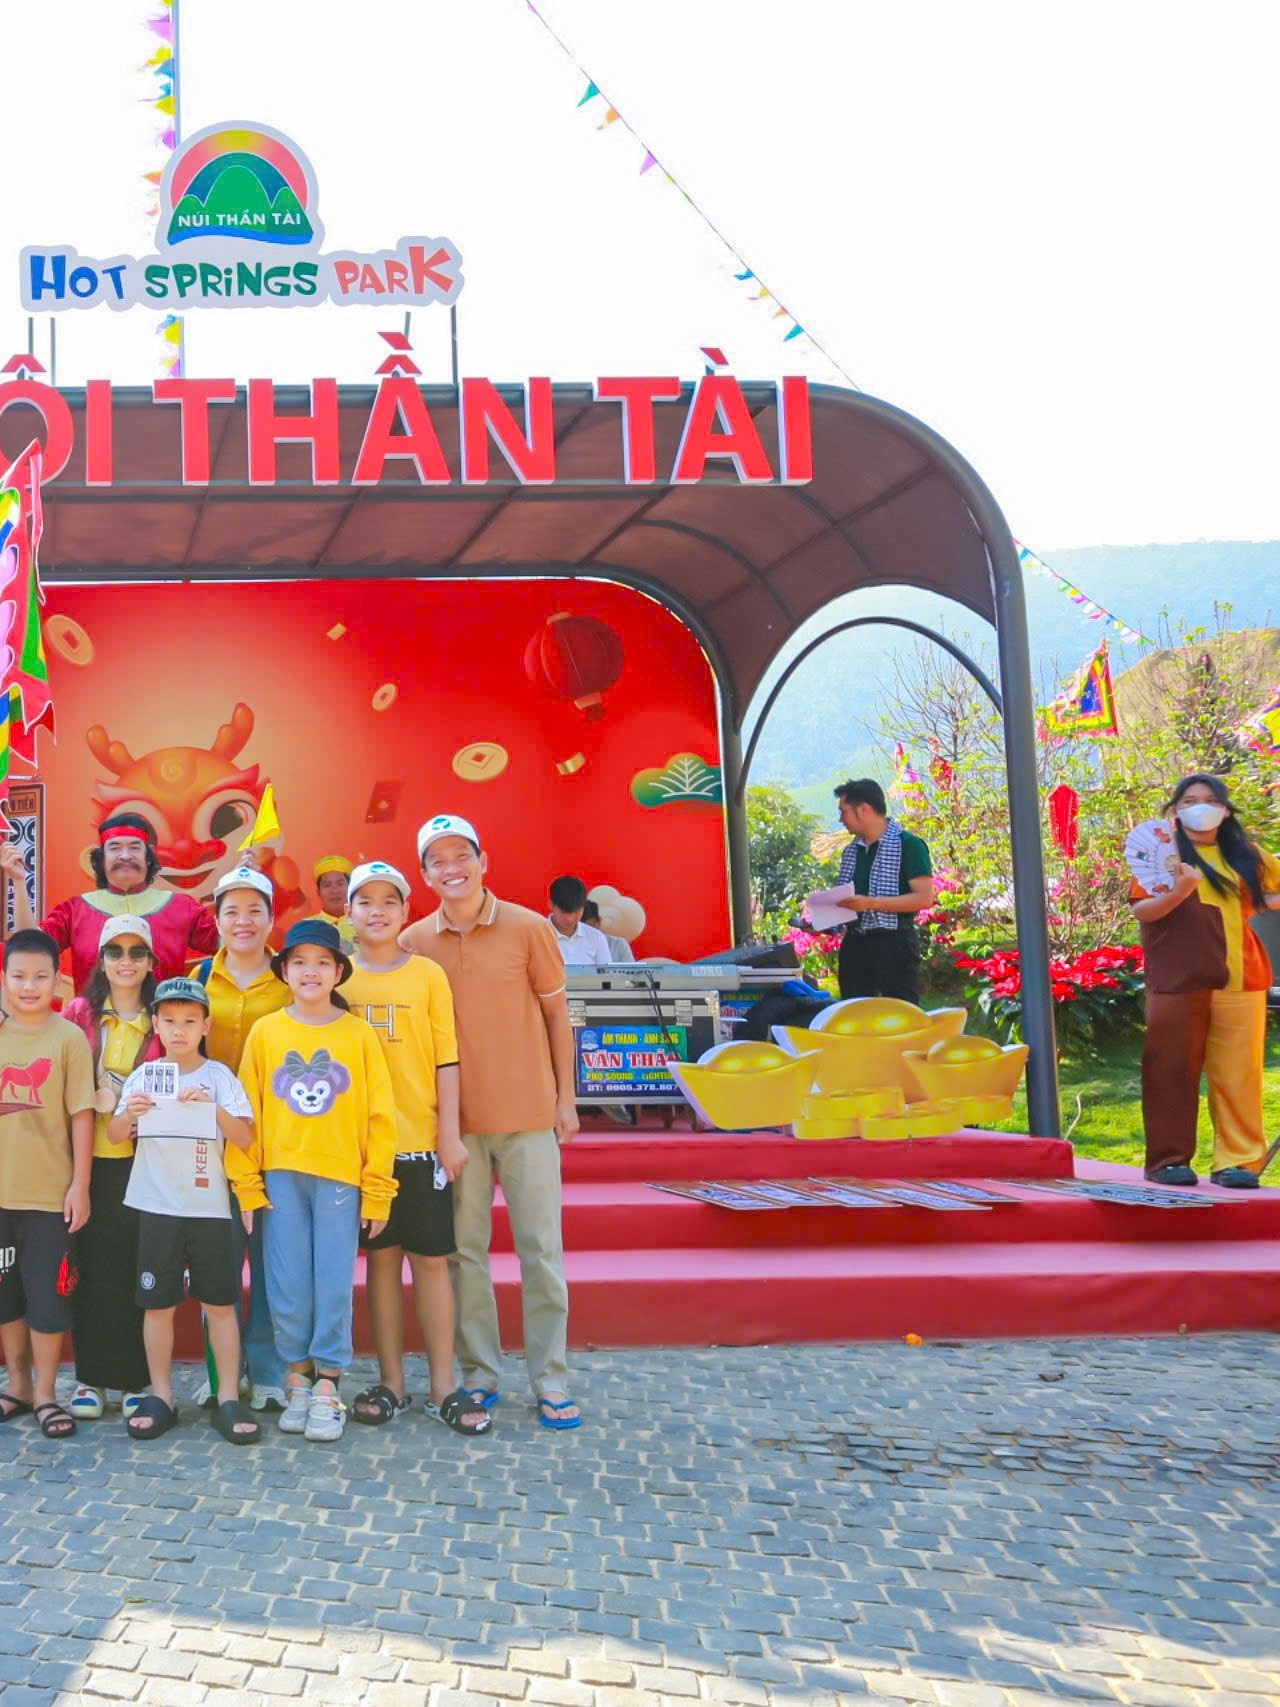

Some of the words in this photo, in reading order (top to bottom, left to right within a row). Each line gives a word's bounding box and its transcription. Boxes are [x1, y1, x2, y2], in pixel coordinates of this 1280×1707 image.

[178, 211, 209, 227] NÚI
[272, 209, 301, 225] TÀI
[30, 254, 127, 300] HOT
[334, 246, 454, 294] PARK
[153, 331, 555, 486] THẦN
[594, 347, 813, 486] TÀI
